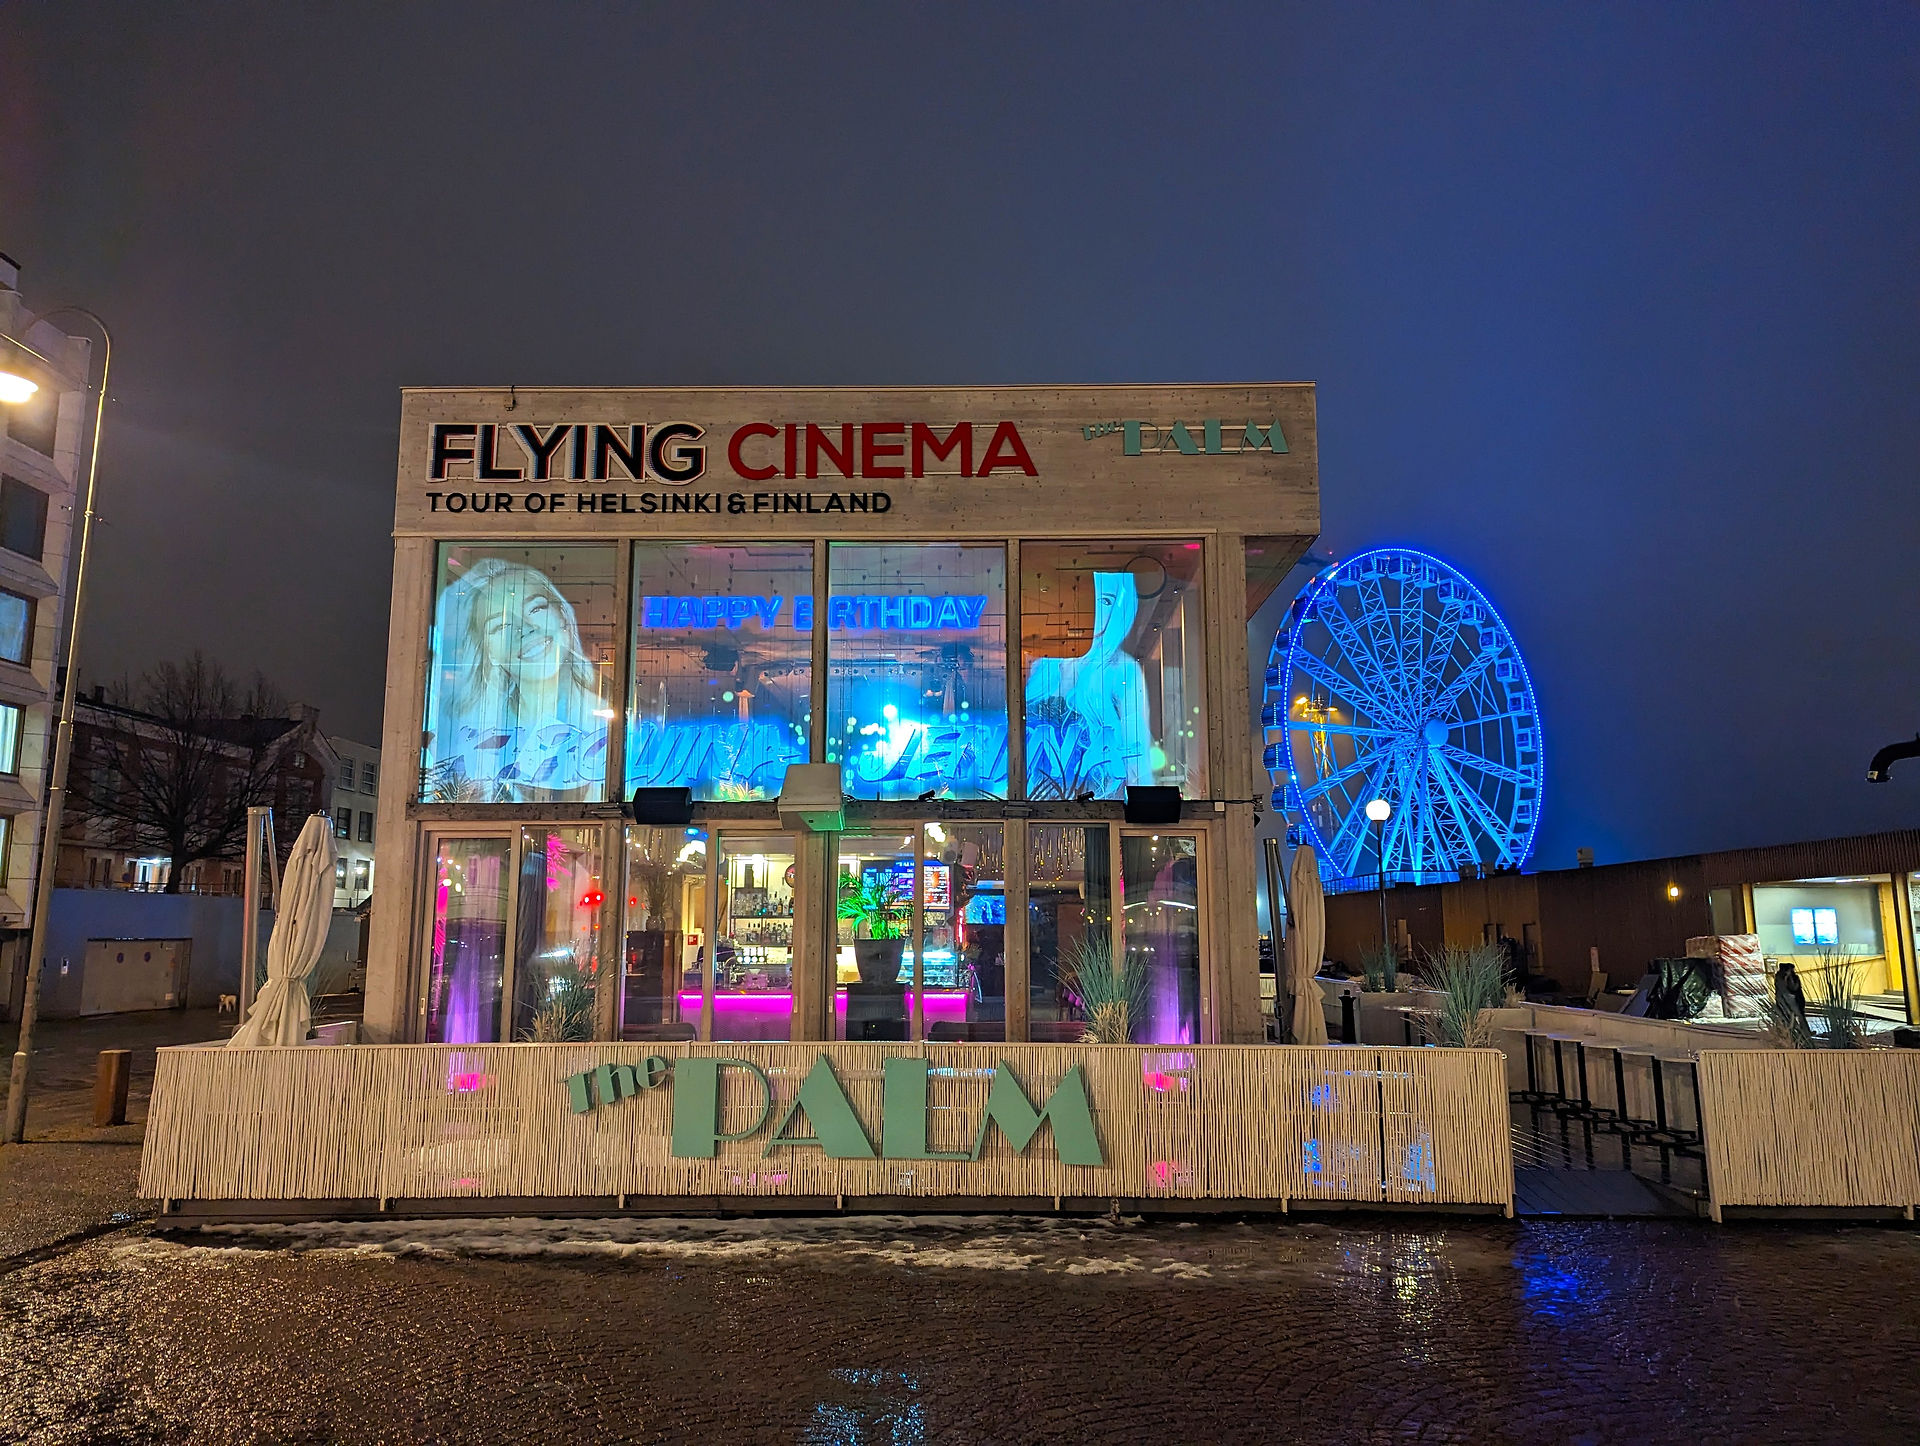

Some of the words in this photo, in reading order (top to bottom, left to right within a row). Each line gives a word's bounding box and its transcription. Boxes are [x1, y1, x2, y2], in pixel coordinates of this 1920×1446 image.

[426, 421, 706, 485] FLYING
[728, 421, 1038, 480] CINEMA
[1123, 418, 1289, 456] PALM
[426, 492, 513, 513] TOUR
[524, 492, 566, 513] OF
[577, 492, 721, 513] HELSINKI
[727, 492, 746, 514] &
[752, 492, 892, 513] FINLAND
[642, 595, 783, 629] HAPPY
[793, 595, 989, 631] BRTHDAY
[672, 1053, 1105, 1165] PALM
